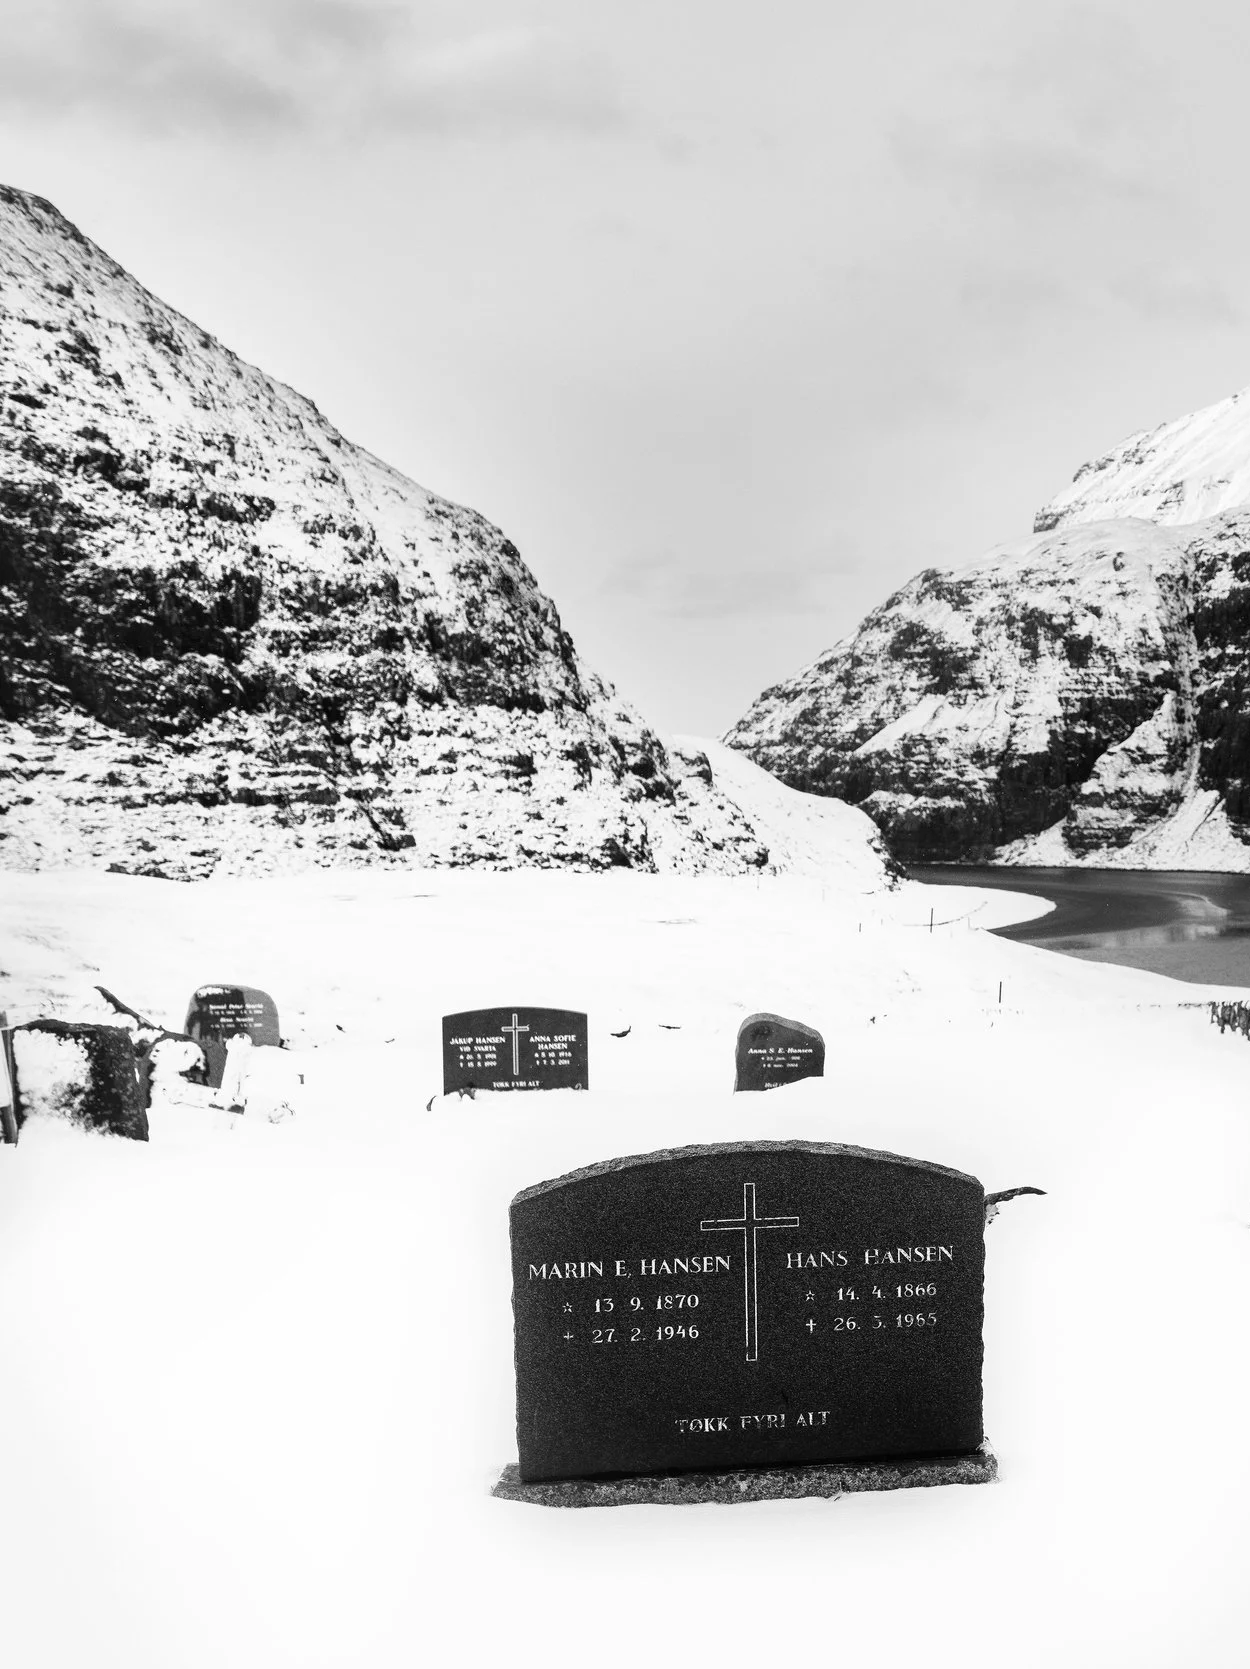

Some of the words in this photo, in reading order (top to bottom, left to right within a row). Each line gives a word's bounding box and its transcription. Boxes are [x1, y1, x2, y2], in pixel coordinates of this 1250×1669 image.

[529, 1035, 551, 1043] ANNA
[553, 1034, 577, 1042] SOFIE
[786, 1250, 849, 1269] HANS
[863, 1245, 954, 1266] HANSEN
[528, 1261, 604, 1281] MARIN
[640, 1255, 732, 1276] HANSEN
[837, 1286, 860, 1301] 14.
[871, 1285, 887, 1300] 4.
[895, 1282, 938, 1299] 1866
[656, 1294, 700, 1311] 1870
[833, 1316, 861, 1331] 26.
[895, 1312, 938, 1329] 1965
[656, 1324, 700, 1342] 1946
[739, 1413, 786, 1430] FYRI
[796, 1411, 831, 1427] ALT
